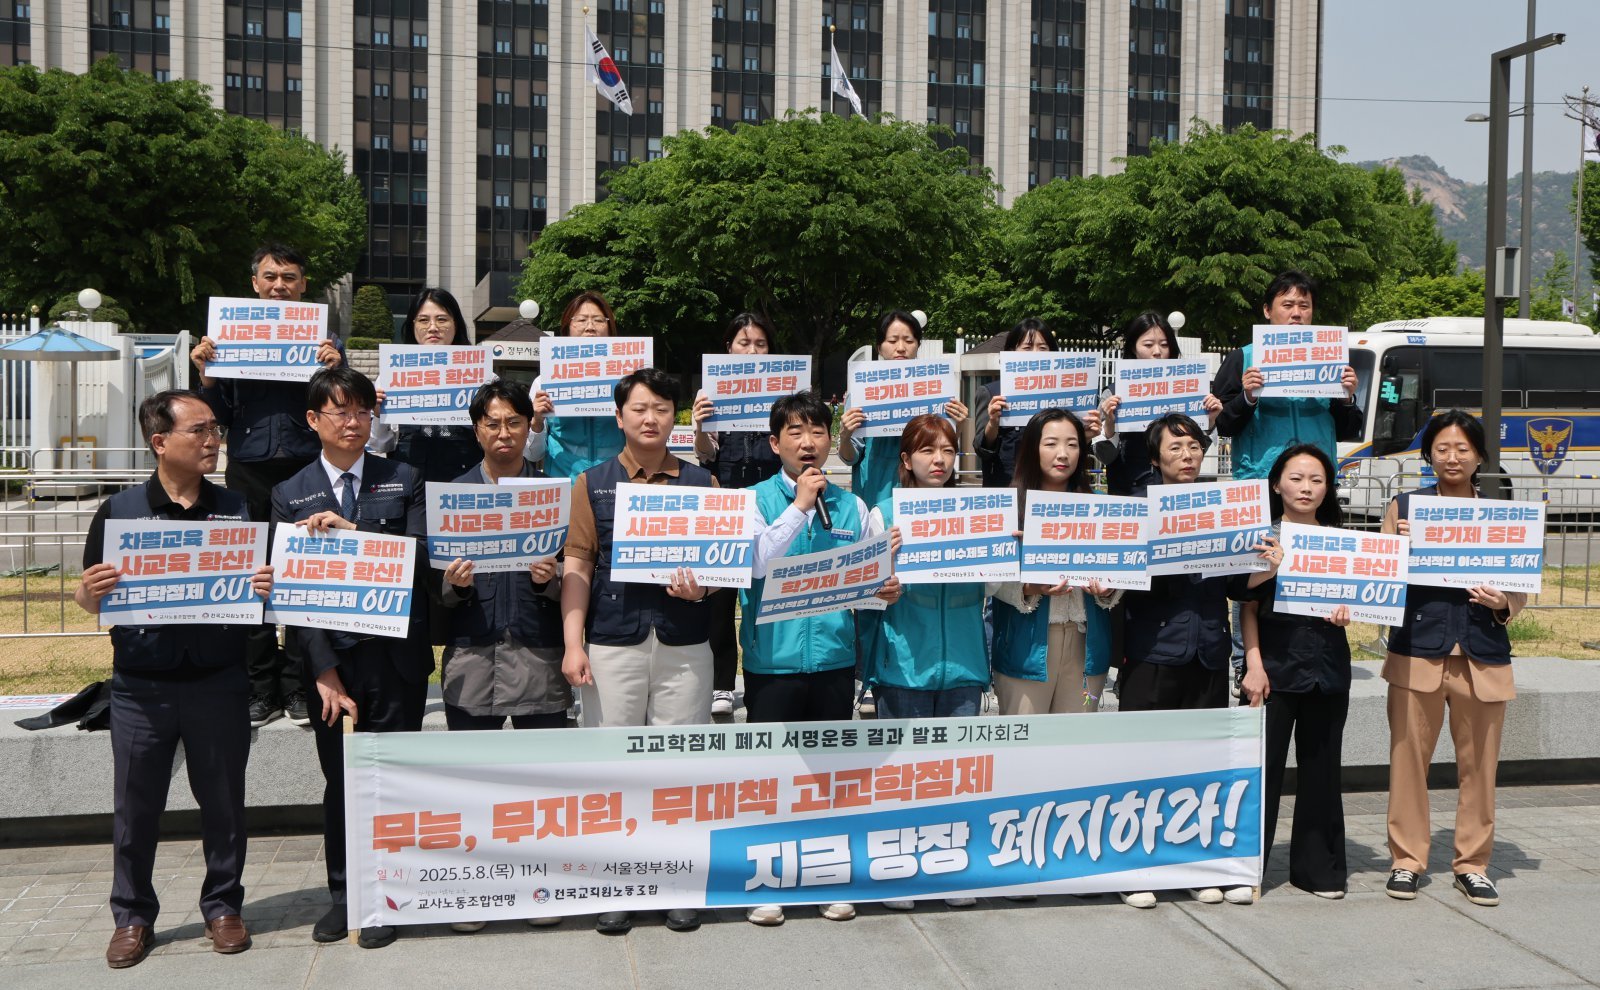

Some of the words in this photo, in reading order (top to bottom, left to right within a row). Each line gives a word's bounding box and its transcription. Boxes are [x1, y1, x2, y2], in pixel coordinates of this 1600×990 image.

[219, 307, 280, 320] 차별교육
[285, 307, 319, 320] 확대!
[218, 325, 271, 340] 사교육
[277, 324, 318, 340] 확산!
[1263, 331, 1313, 346] 차별교육
[1317, 330, 1342, 342] 확대!
[390, 352, 448, 367] 차별교육
[452, 350, 485, 364] 확대!
[551, 344, 608, 360] 차별교육
[612, 341, 645, 356] 확대!
[1262, 348, 1307, 363] 사교육
[1311, 346, 1342, 360] 확산!
[551, 362, 600, 380] 사교육
[708, 362, 756, 376] 학생부담
[759, 360, 806, 373] 가중하는
[855, 368, 902, 383] 학생부담
[905, 364, 949, 378] 가중하는
[1006, 360, 1051, 372] 학생부담
[1054, 357, 1096, 370] 가중하는
[1120, 367, 1163, 380] 학생부담
[1166, 364, 1206, 377] 가중하는
[390, 370, 440, 387] 사교육
[446, 368, 484, 385] 확산!
[717, 378, 761, 395] 학기제
[767, 376, 797, 391] 중단
[1015, 374, 1056, 390] 학기제
[1061, 373, 1088, 388] 중단
[546, 384, 611, 400] 고교학점제
[865, 383, 908, 400] 학기제
[913, 380, 942, 396] 중단
[1129, 382, 1168, 397] 학기제
[1173, 379, 1199, 394] 중단
[384, 393, 451, 410] 고교학점제
[712, 405, 741, 416] 식적인
[1040, 398, 1073, 408] 이수제도
[1077, 394, 1096, 406] 폐지
[864, 410, 890, 421] 식적인
[440, 493, 512, 510] 차별교육
[518, 488, 560, 506] 확대!
[628, 495, 699, 511] 차별교육
[704, 495, 745, 511] 확대!
[899, 498, 956, 515] 학생부담
[961, 494, 1012, 511] 가중하는
[1160, 489, 1221, 512] 차별교육
[1226, 485, 1260, 503] 확대!
[1032, 504, 1090, 517] 학생부담
[1094, 503, 1148, 517] 가중하는
[1415, 508, 1474, 521] 학생부담
[1478, 507, 1538, 520] 가중하는
[440, 514, 503, 532] 사교육
[510, 508, 559, 529] 확산!
[626, 517, 688, 536] 사교육
[695, 516, 743, 536] 확산!
[911, 517, 964, 538] 학기제
[970, 514, 1004, 533] 중단
[1159, 511, 1215, 535] 사교육
[1221, 506, 1261, 527] 확산!
[119, 529, 203, 550] 차별교육
[209, 527, 256, 546] 확대!
[1041, 522, 1096, 540] 학기제
[1102, 522, 1139, 539] 중단
[1425, 526, 1481, 543] 학기제
[1487, 526, 1526, 543] 중단
[285, 536, 358, 556] 차별교육
[363, 540, 406, 558] 확대!
[434, 539, 516, 557] 고교학점제
[522, 528, 566, 554] OUT
[1152, 538, 1226, 560] 고교학점제
[1292, 534, 1356, 552] 차별교육
[1362, 538, 1400, 554] 확대!
[617, 546, 700, 564] 고교학점제
[705, 542, 749, 565] OUT
[773, 559, 833, 579] 학생부담
[836, 540, 887, 568] 가중하는
[897, 550, 942, 565] 형식적인
[944, 546, 987, 560] 이수제도
[992, 541, 1016, 557] 폐지
[1024, 552, 1070, 564] 형식적인
[1073, 552, 1119, 564] 이수제도
[1408, 556, 1455, 567] 형식적인
[1458, 556, 1505, 567] 이수제도
[1510, 554, 1540, 568] 폐지
[120, 552, 190, 576] 사교육
[198, 550, 254, 572] 확산!
[282, 559, 346, 580] 사교육
[353, 562, 403, 583] 확산!
[1289, 555, 1347, 575] 사교육
[1353, 557, 1398, 577] 확산!
[781, 573, 839, 594] 학기제
[844, 562, 879, 585] 중단
[108, 583, 205, 606] 고교학점제
[210, 577, 255, 601] OUT
[272, 589, 358, 608] 고교학점제
[362, 589, 408, 613] OUT
[762, 599, 809, 613] 형식적인
[812, 591, 859, 604] 이수제도
[864, 587, 879, 597] 폐
[1280, 581, 1357, 600] 고교학점제
[1361, 582, 1404, 604] OUT
[627, 733, 726, 753] 고교학점제
[735, 731, 773, 750] 폐지
[782, 729, 858, 749] 서명운동
[868, 727, 904, 747] 결과
[912, 725, 948, 745] 발표
[957, 723, 1030, 743] 기자회견
[373, 811, 477, 853] 무능,
[493, 792, 637, 844] 무지원,
[652, 777, 778, 825] 무대책
[791, 754, 994, 813] 고교학점제
[744, 835, 851, 892] 지금
[867, 820, 971, 882] 당장
[988, 779, 1249, 870] 폐지하라!
[420, 864, 514, 882] 2025.5.8.(목)
[520, 863, 547, 876] 11시
[603, 860, 694, 875] 서울정부청사
[417, 894, 515, 909] 교사노동조합연맹
[554, 885, 658, 900] 전국교직원노동조합
